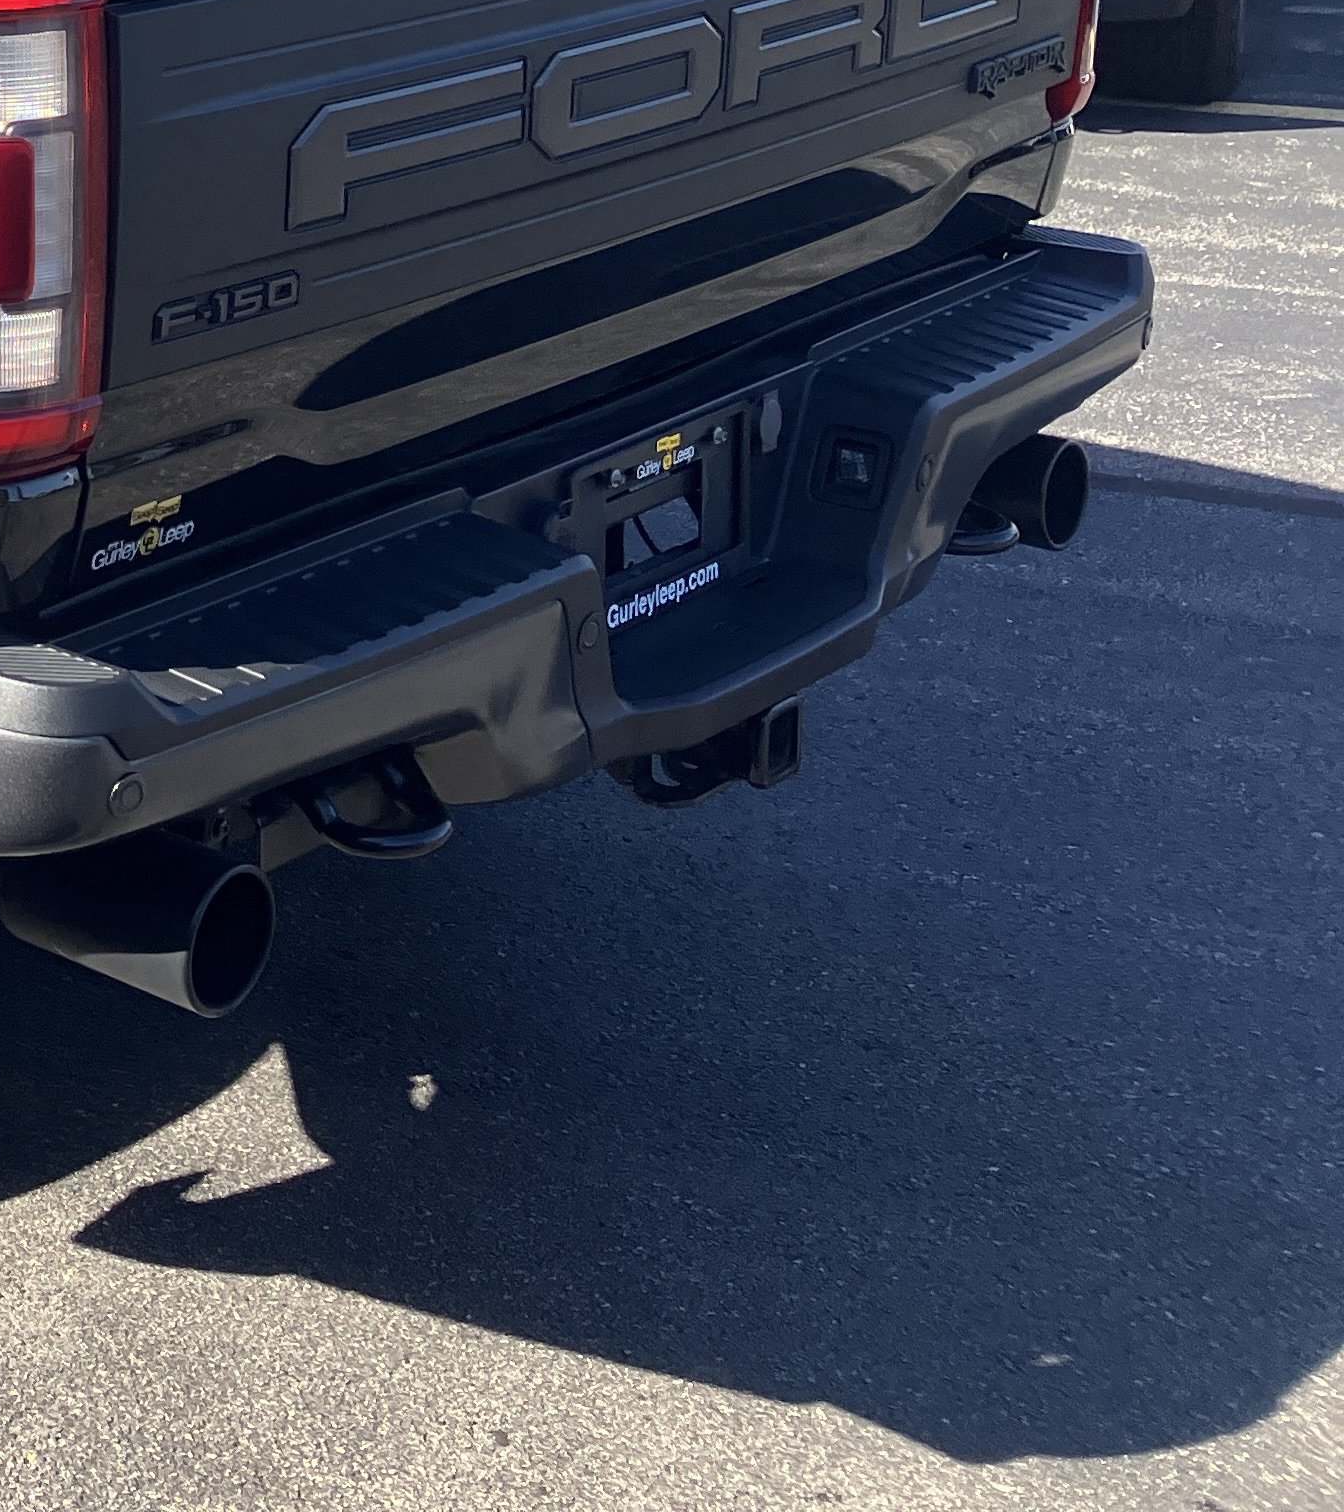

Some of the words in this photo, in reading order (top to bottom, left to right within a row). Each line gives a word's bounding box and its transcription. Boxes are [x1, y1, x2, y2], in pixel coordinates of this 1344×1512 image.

[970, 35, 1065, 99] RAPTOR
[152, 269, 301, 345] F-150
[673, 444, 695, 465] Leep
[92, 539, 141, 571] Gurley
[158, 519, 195, 548] Leep
[607, 561, 720, 629] Gurleyleep.com
